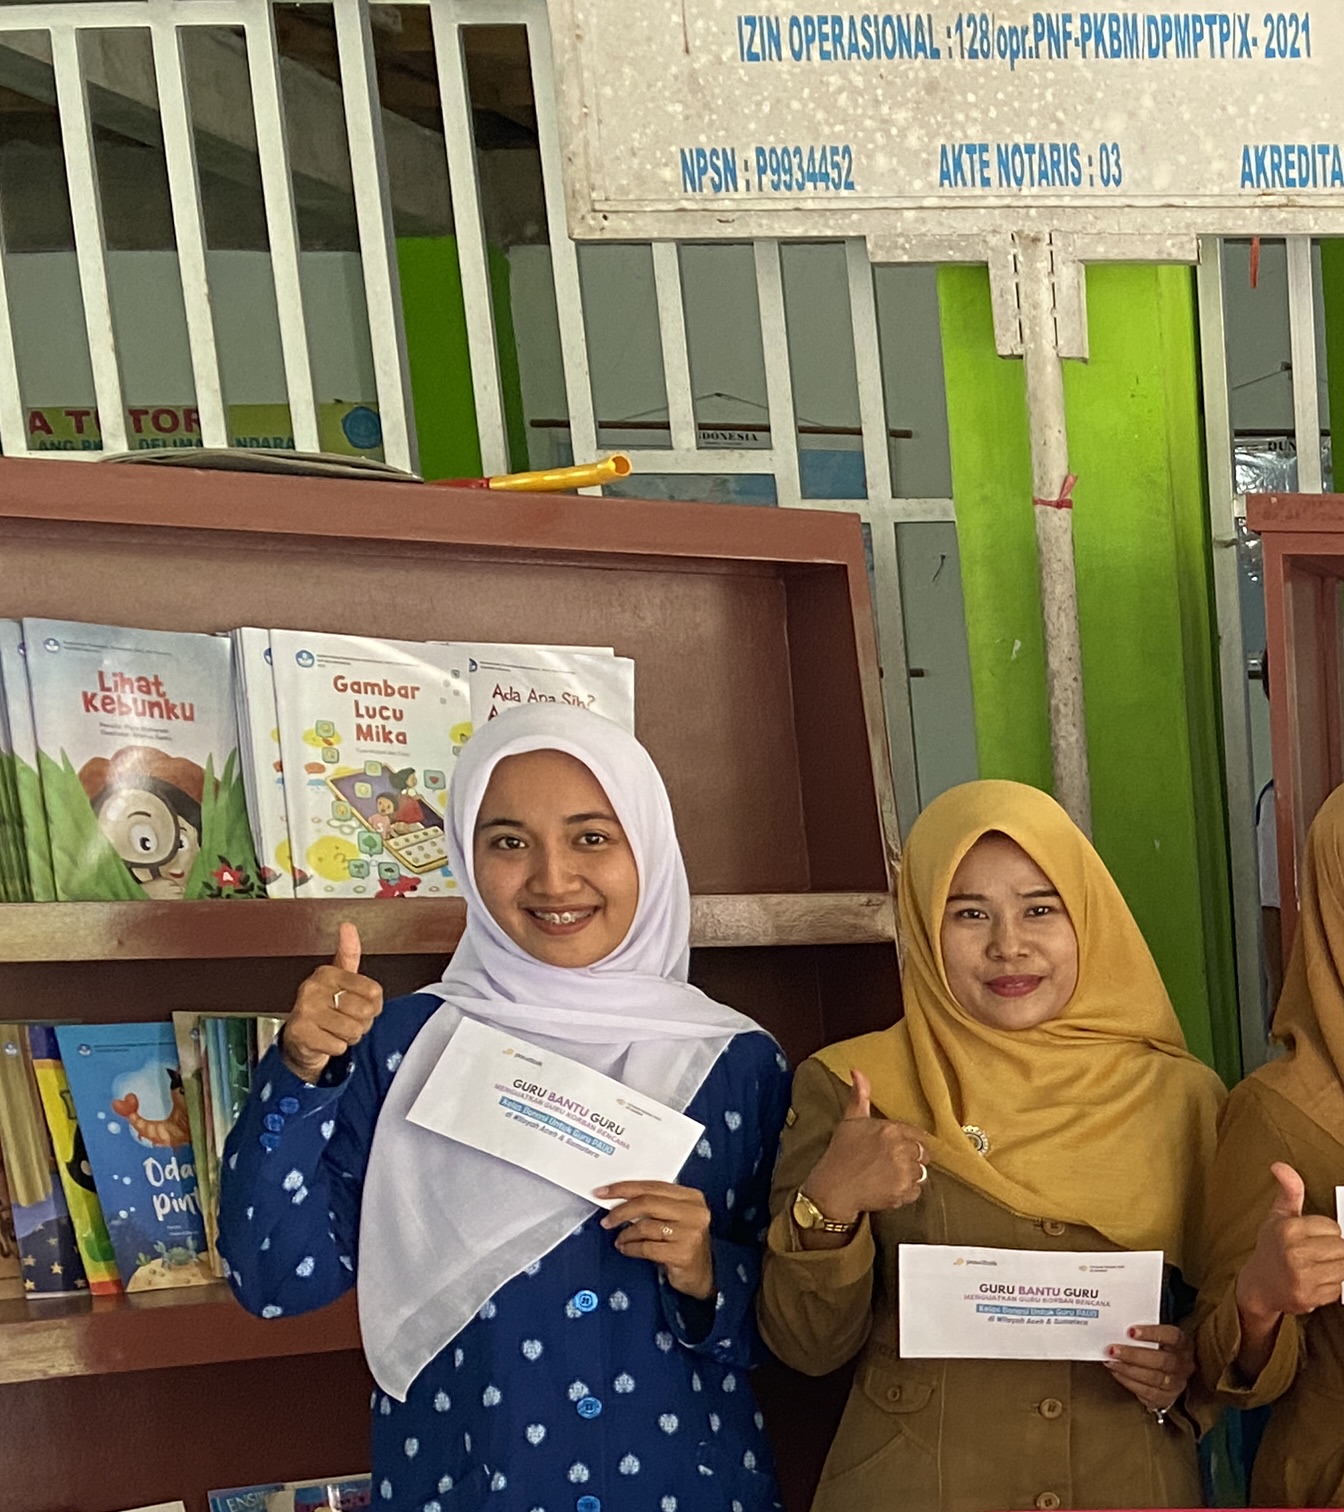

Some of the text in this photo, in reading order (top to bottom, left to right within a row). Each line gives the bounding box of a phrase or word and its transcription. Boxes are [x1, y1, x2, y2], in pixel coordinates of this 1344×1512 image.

[737, 15, 782, 62] IZIN
[789, 13, 940, 62] OPERASIONAL
[1264, 12, 1311, 58] 2021
[680, 147, 738, 193] NPSN
[756, 144, 855, 191] P9934452
[939, 143, 991, 187] AKTE
[999, 143, 1081, 187] NOTARIS
[1100, 142, 1122, 188] 03
[698, 431, 758, 442] DONESIA
[98, 670, 166, 698] Lihat
[333, 675, 420, 699] Gambar
[492, 683, 521, 702] Ada
[82, 691, 195, 722] Kebunku
[354, 699, 404, 721] Lucu
[356, 723, 407, 744] Mika
[512, 1078, 548, 1098] GURU
[547, 1092, 589, 1118] BANTU
[590, 1112, 626, 1137] GURU
[142, 1156, 196, 1188] Oda
[152, 1189, 201, 1221] pint
[979, 1283, 1099, 1299] GURU BANTU GURU
